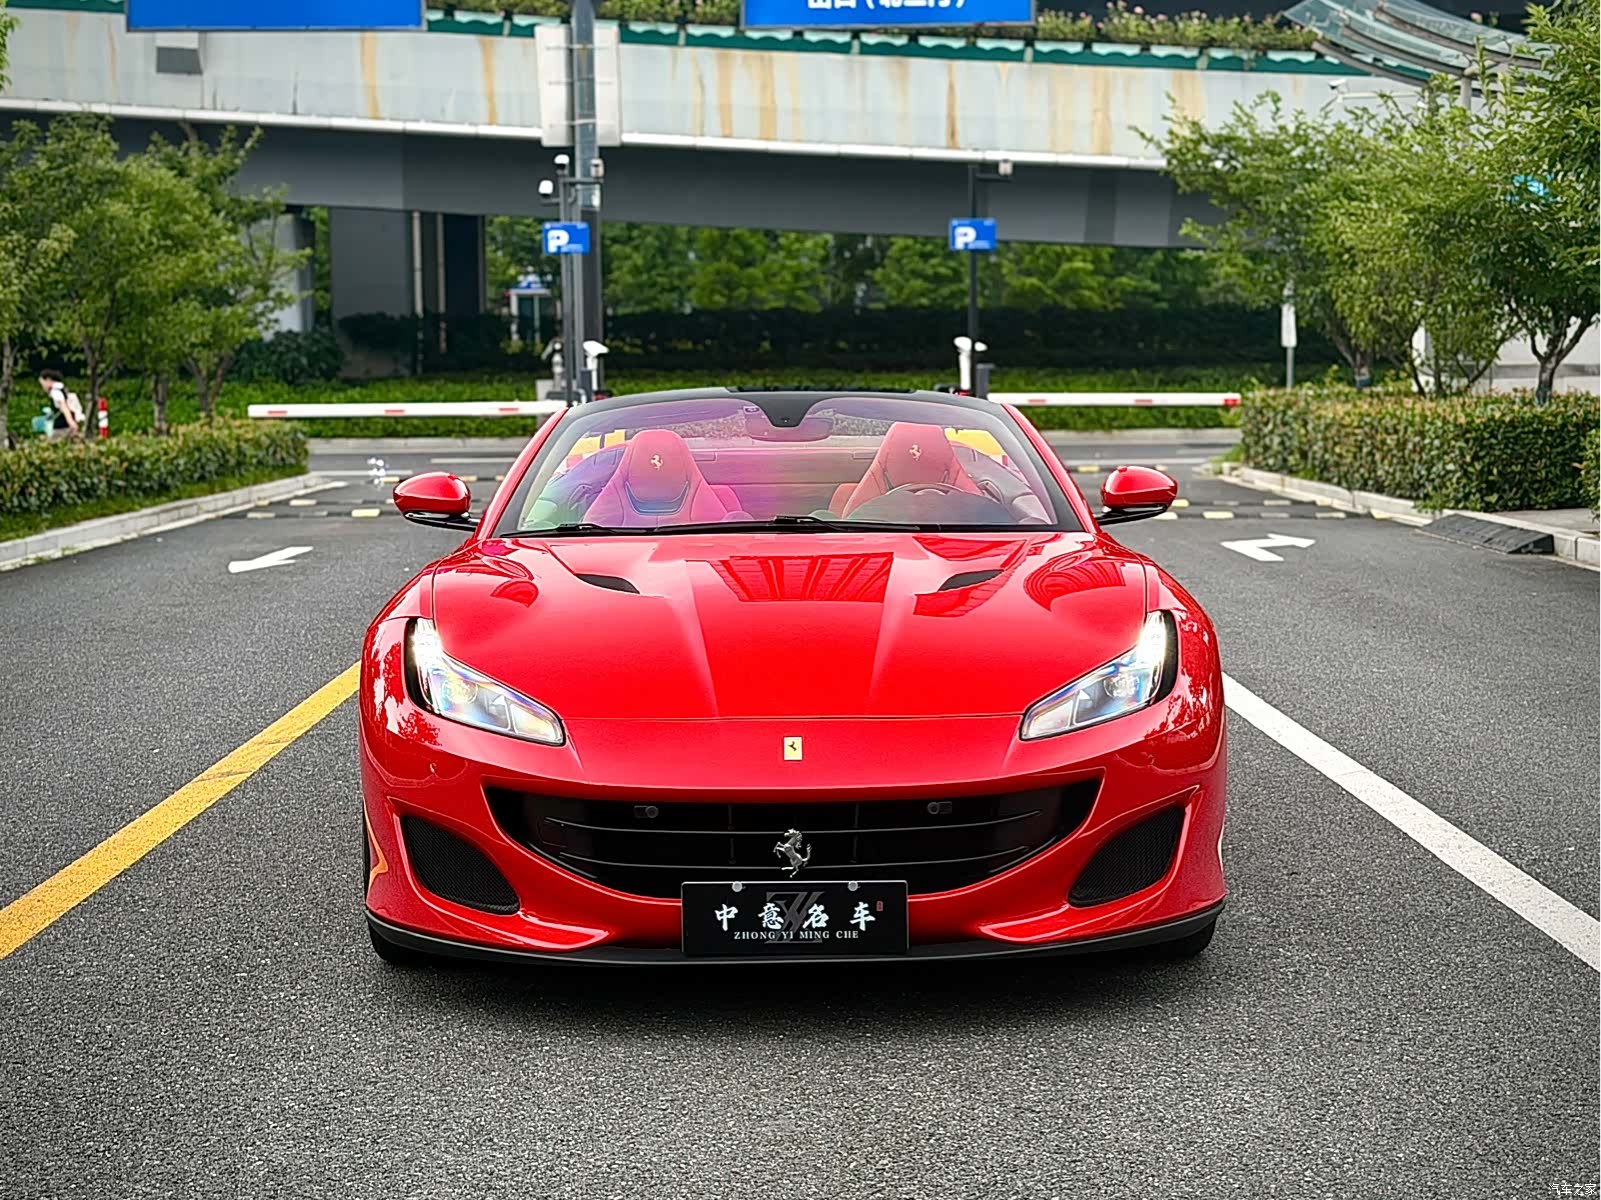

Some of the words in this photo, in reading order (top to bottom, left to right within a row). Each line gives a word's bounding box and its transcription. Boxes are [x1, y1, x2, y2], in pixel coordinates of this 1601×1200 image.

[547, 229, 570, 253] P
[955, 226, 976, 250] P
[714, 902, 876, 931] 中意名车
[733, 931, 776, 940] ZHONG
[781, 931, 794, 939] YI
[799, 931, 830, 939] MING
[835, 930, 859, 939] CHE
